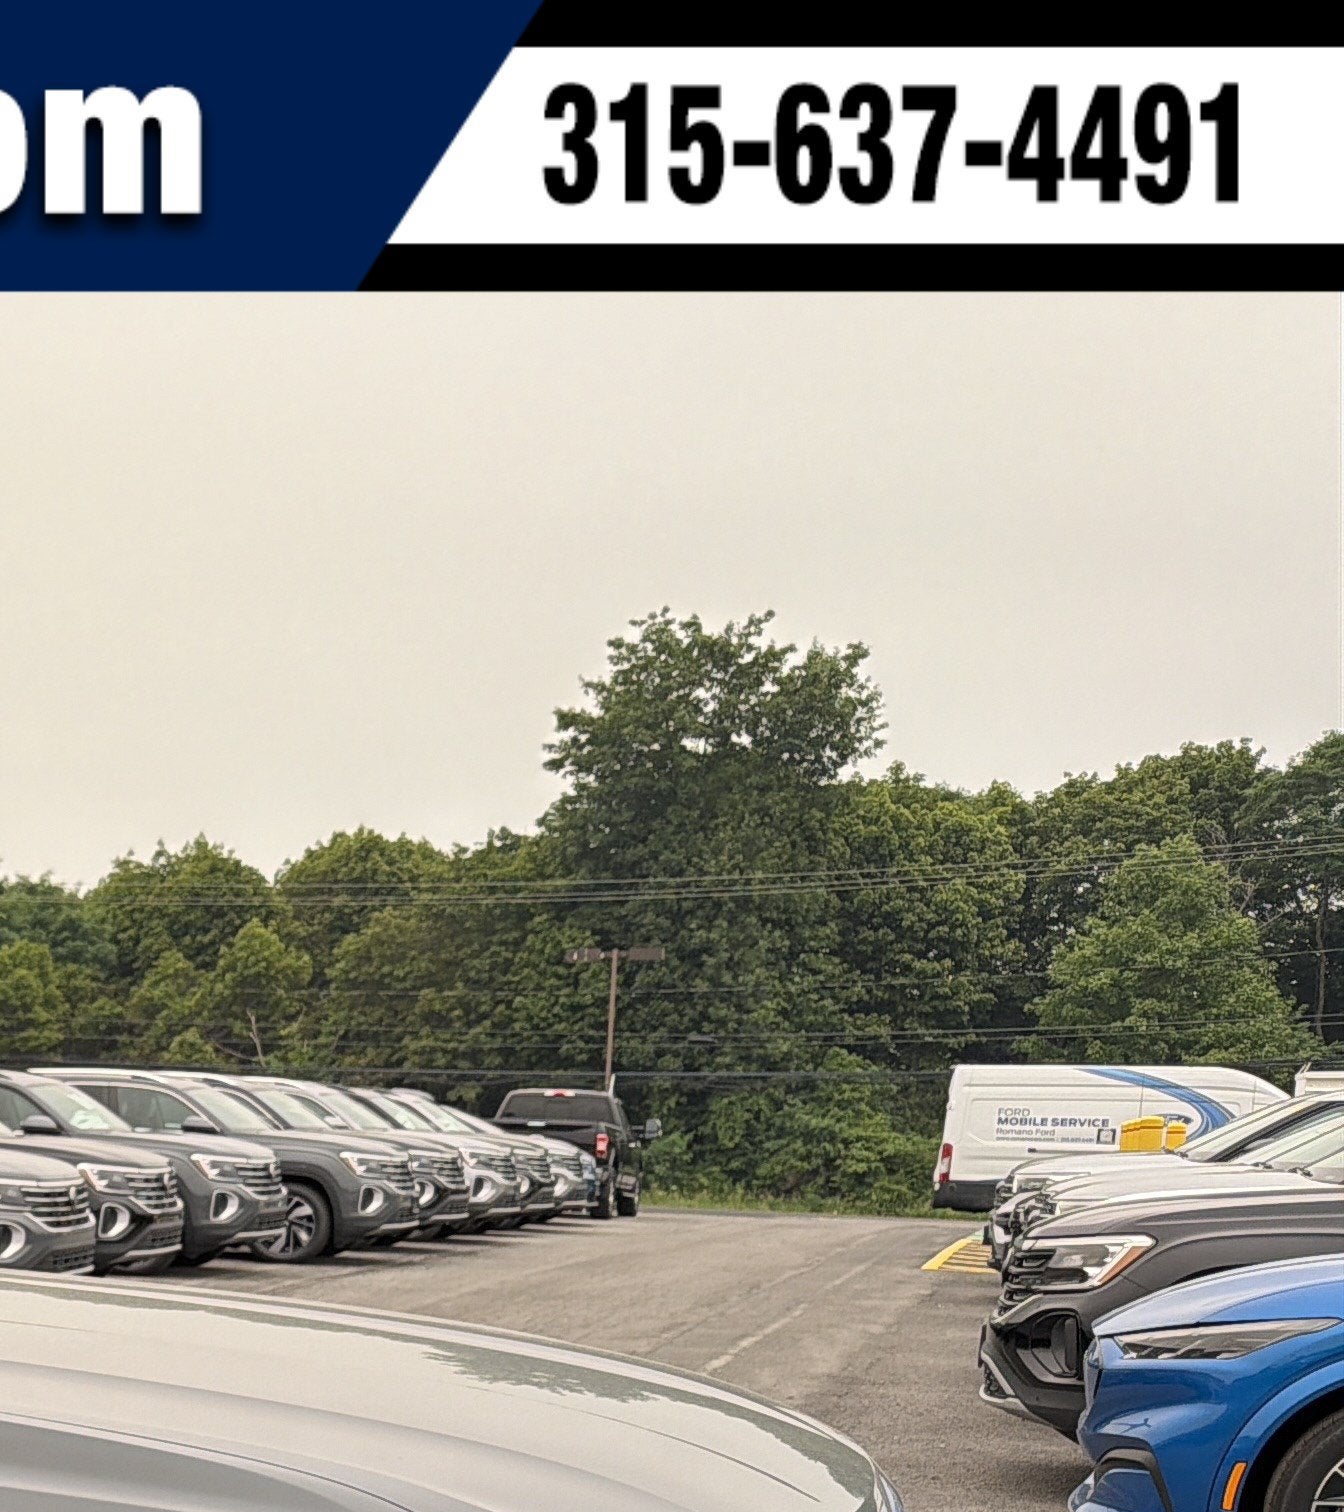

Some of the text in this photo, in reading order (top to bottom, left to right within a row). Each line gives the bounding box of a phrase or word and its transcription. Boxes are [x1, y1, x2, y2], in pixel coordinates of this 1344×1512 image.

[997, 1107, 1030, 1117] FORD
[997, 1117, 1110, 1128] MOBILE SERVICE
[995, 1127, 1056, 1137] Romano Ford
